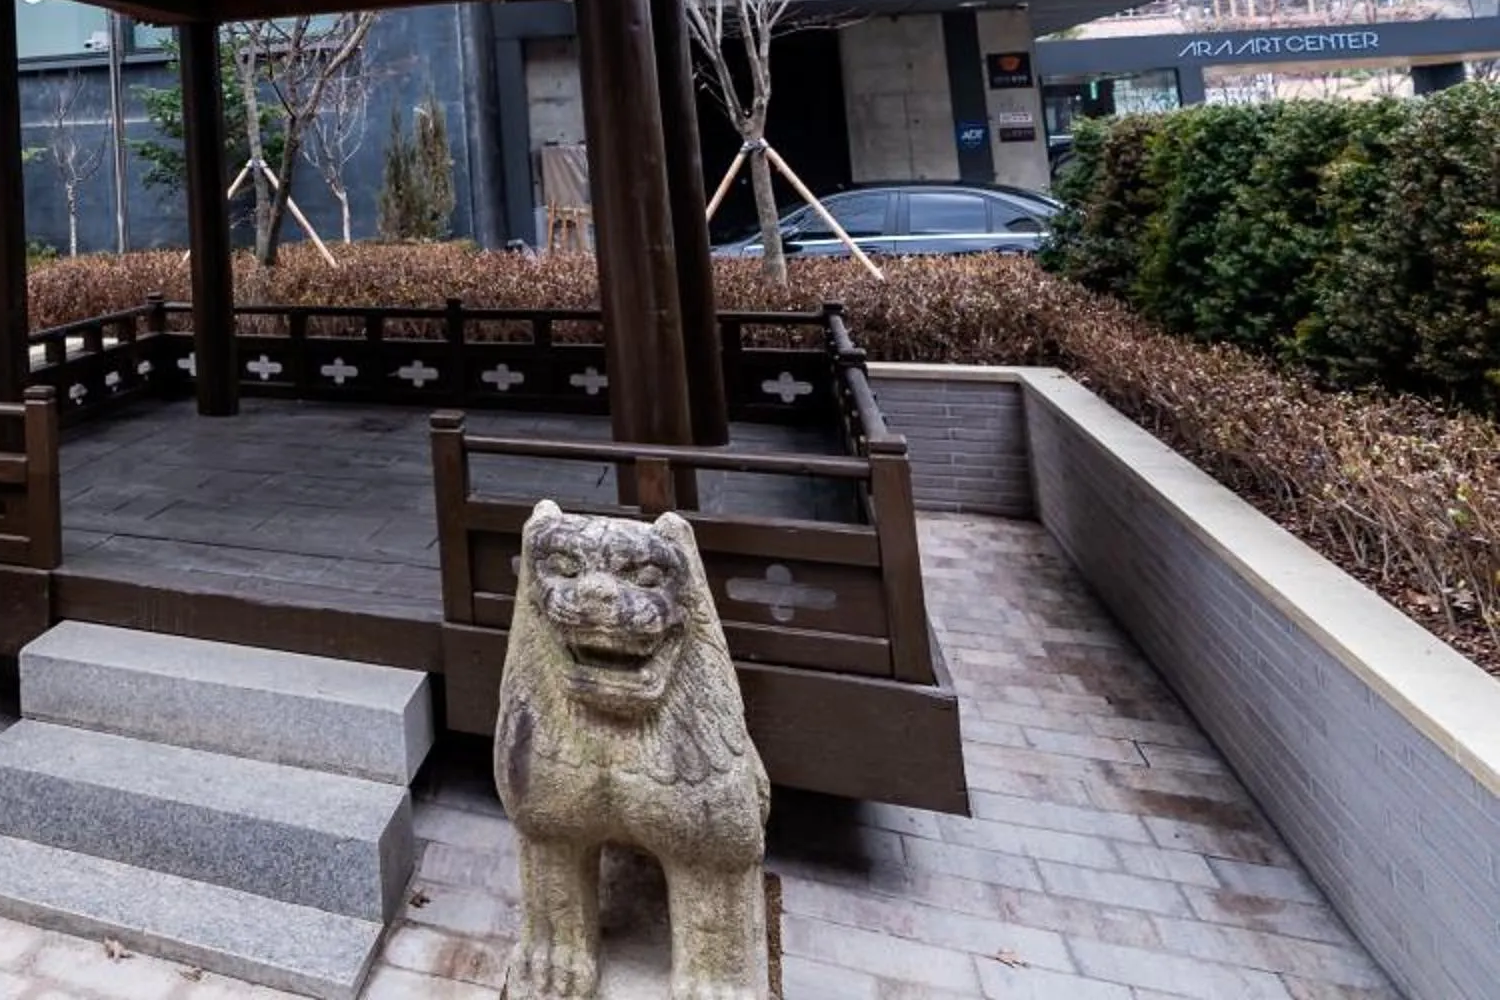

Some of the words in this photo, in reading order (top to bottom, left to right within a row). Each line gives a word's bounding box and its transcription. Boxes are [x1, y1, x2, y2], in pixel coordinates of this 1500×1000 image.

[1178, 39, 1233, 58] ARA
[1235, 36, 1282, 55] ART
[1285, 31, 1380, 53] CENTER
